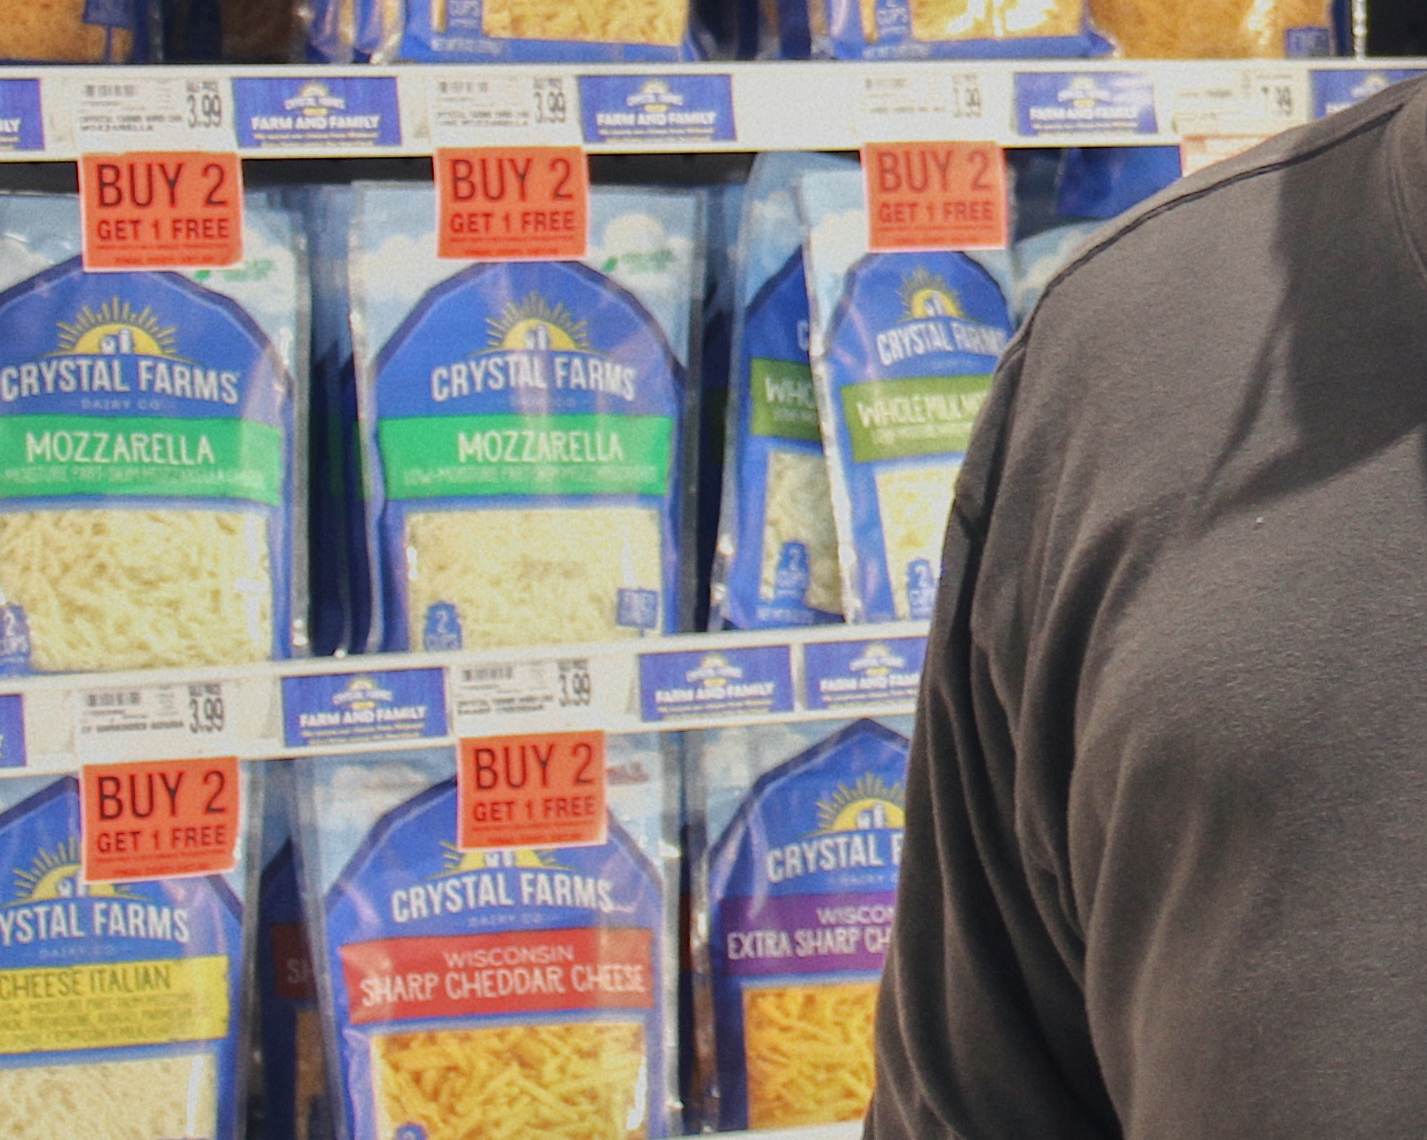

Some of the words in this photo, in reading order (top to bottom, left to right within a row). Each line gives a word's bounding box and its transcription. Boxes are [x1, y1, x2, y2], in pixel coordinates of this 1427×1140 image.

[186, 94, 223, 128] 3.99
[252, 113, 293, 131] FARM
[295, 113, 328, 131] AND
[329, 113, 381, 131] FAMILY
[533, 91, 567, 125] 3.99
[596, 112, 636, 128] FARM
[637, 112, 667, 127] AND
[668, 111, 717, 127] FAMILY
[97, 163, 183, 208] BUY
[201, 163, 228, 207] 2
[452, 158, 533, 204] BUY
[549, 158, 575, 200] 2
[877, 149, 953, 194] BUY
[967, 148, 992, 192] 2
[451, 212, 494, 235] GET
[502, 212, 511, 233] 1
[521, 210, 576, 234] FREE
[880, 201, 918, 224] GET
[926, 202, 935, 224] 1
[943, 199, 994, 222] FREE
[98, 219, 142, 242] GET
[151, 220, 161, 241] 1
[172, 218, 230, 240] FREE
[876, 319, 954, 367] CRYSTAL
[1, 359, 131, 403] CRYSTAL
[138, 360, 241, 405] FARMS
[431, 355, 547, 403] CRYSTAL
[554, 356, 638, 402] FARMS
[25, 430, 216, 466] MOZZARELLA
[457, 430, 624, 464] MOZZARELLA
[558, 672, 592, 707] 3.99
[655, 688, 694, 704] FARM
[696, 686, 725, 701] AND
[726, 682, 775, 698] FAMILY
[188, 696, 225, 735] 3.99
[298, 711, 341, 729] FARM
[342, 709, 375, 726] AND
[376, 705, 427, 722] FAMILY
[475, 742, 557, 792] BUY
[571, 741, 597, 786] 2
[98, 770, 185, 821] BUY
[202, 769, 227, 816] 2
[473, 799, 516, 824] GET
[523, 798, 534, 821] 1
[542, 794, 597, 820] FREE
[96, 831, 142, 855] GET
[151, 830, 161, 852] 1
[172, 825, 228, 850] FREE
[766, 831, 886, 884] CRYSTAL
[390, 872, 515, 924] CRYSTAL
[520, 872, 616, 914] FARMS
[0, 901, 86, 948] YSTAL
[93, 900, 192, 944] FARMS
[442, 943, 576, 970] WISCONSIN
[726, 929, 794, 962] EXTRA
[795, 925, 861, 958] SHARP
[89, 965, 173, 995] ITALIAN
[359, 971, 441, 1009] SHARP
[444, 965, 566, 1001] CHEDDAR
[570, 962, 649, 995] CHEESE
